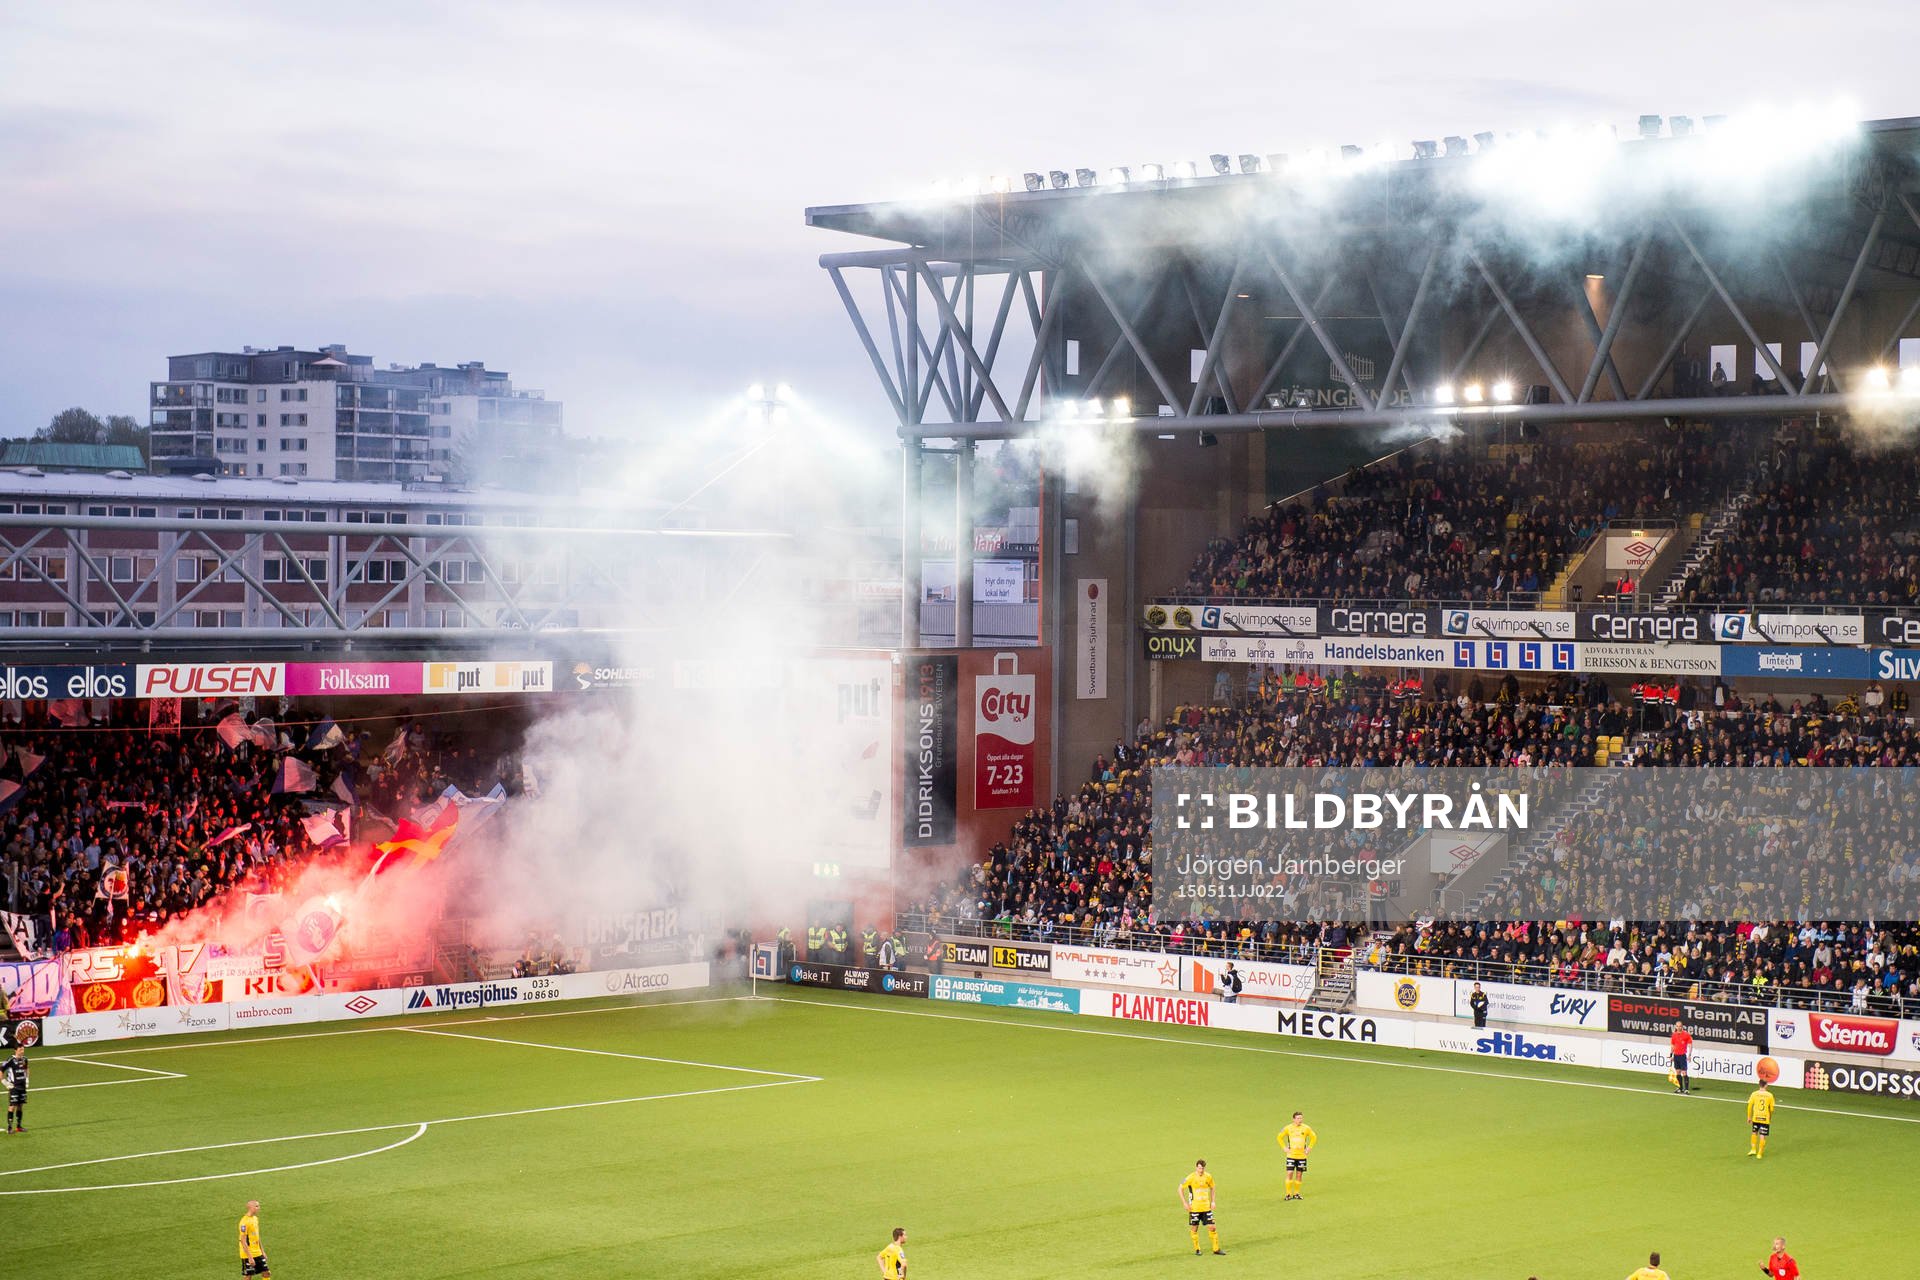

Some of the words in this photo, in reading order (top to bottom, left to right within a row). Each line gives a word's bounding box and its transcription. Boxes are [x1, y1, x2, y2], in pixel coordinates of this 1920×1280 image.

[1223, 611, 1312, 630] Golvimporten.se
[1332, 608, 1427, 634] Cernera
[1472, 615, 1570, 634] Golvimporten.se
[1592, 613, 1698, 639] Cernera
[1148, 636, 1196, 657] onyx
[1208, 646, 1236, 657] lamina
[1247, 647, 1274, 659] lamina
[1286, 647, 1314, 659] lamina
[1325, 643, 1444, 662] Handelsbanken
[1584, 657, 1637, 669] ERIKSSON
[1639, 658, 1648, 669] &
[1650, 658, 1717, 670] BENGTSSON
[1766, 656, 1795, 666] Imtech
[67, 666, 127, 698] ellos
[145, 667, 277, 694] PULSEN
[319, 669, 391, 690] Folksam
[981, 687, 1031, 722] City
[987, 764, 1024, 786] 7-23
[623, 972, 669, 989] Atracco
[796, 969, 818, 981] Make
[820, 971, 831, 982] IT
[844, 969, 869, 979] ALWAYS
[844, 978, 868, 986] ONLINE
[1218, 970, 1312, 989] HSARVID.SE
[887, 977, 911, 990] Make
[913, 981, 924, 991] IT
[952, 980, 963, 989] AB
[965, 980, 1004, 994] BOSTÄDER
[436, 984, 518, 1009] Myresjöhus
[523, 991, 534, 1000] 10
[534, 990, 546, 999] 86
[547, 989, 560, 998] 80
[956, 992, 982, 1002] BORÅS
[236, 1006, 292, 1019] umbro.com
[1112, 993, 1209, 1026] PLANTAGEN
[1549, 993, 1597, 1025] EVRY
[1610, 1000, 1680, 1018] Service
[1684, 1005, 1732, 1022] Team
[1737, 1010, 1766, 1025] AB
[126, 1021, 157, 1031] Fzon.se
[186, 1017, 217, 1027] Fzon.se
[1278, 1011, 1377, 1043] MECKA
[1622, 1019, 1753, 1041] www.servceteamab.se
[67, 1027, 97, 1038] Fzon.se
[1621, 1048, 1673, 1068] Swedba
[1693, 1055, 1753, 1076] Sjuhärad
